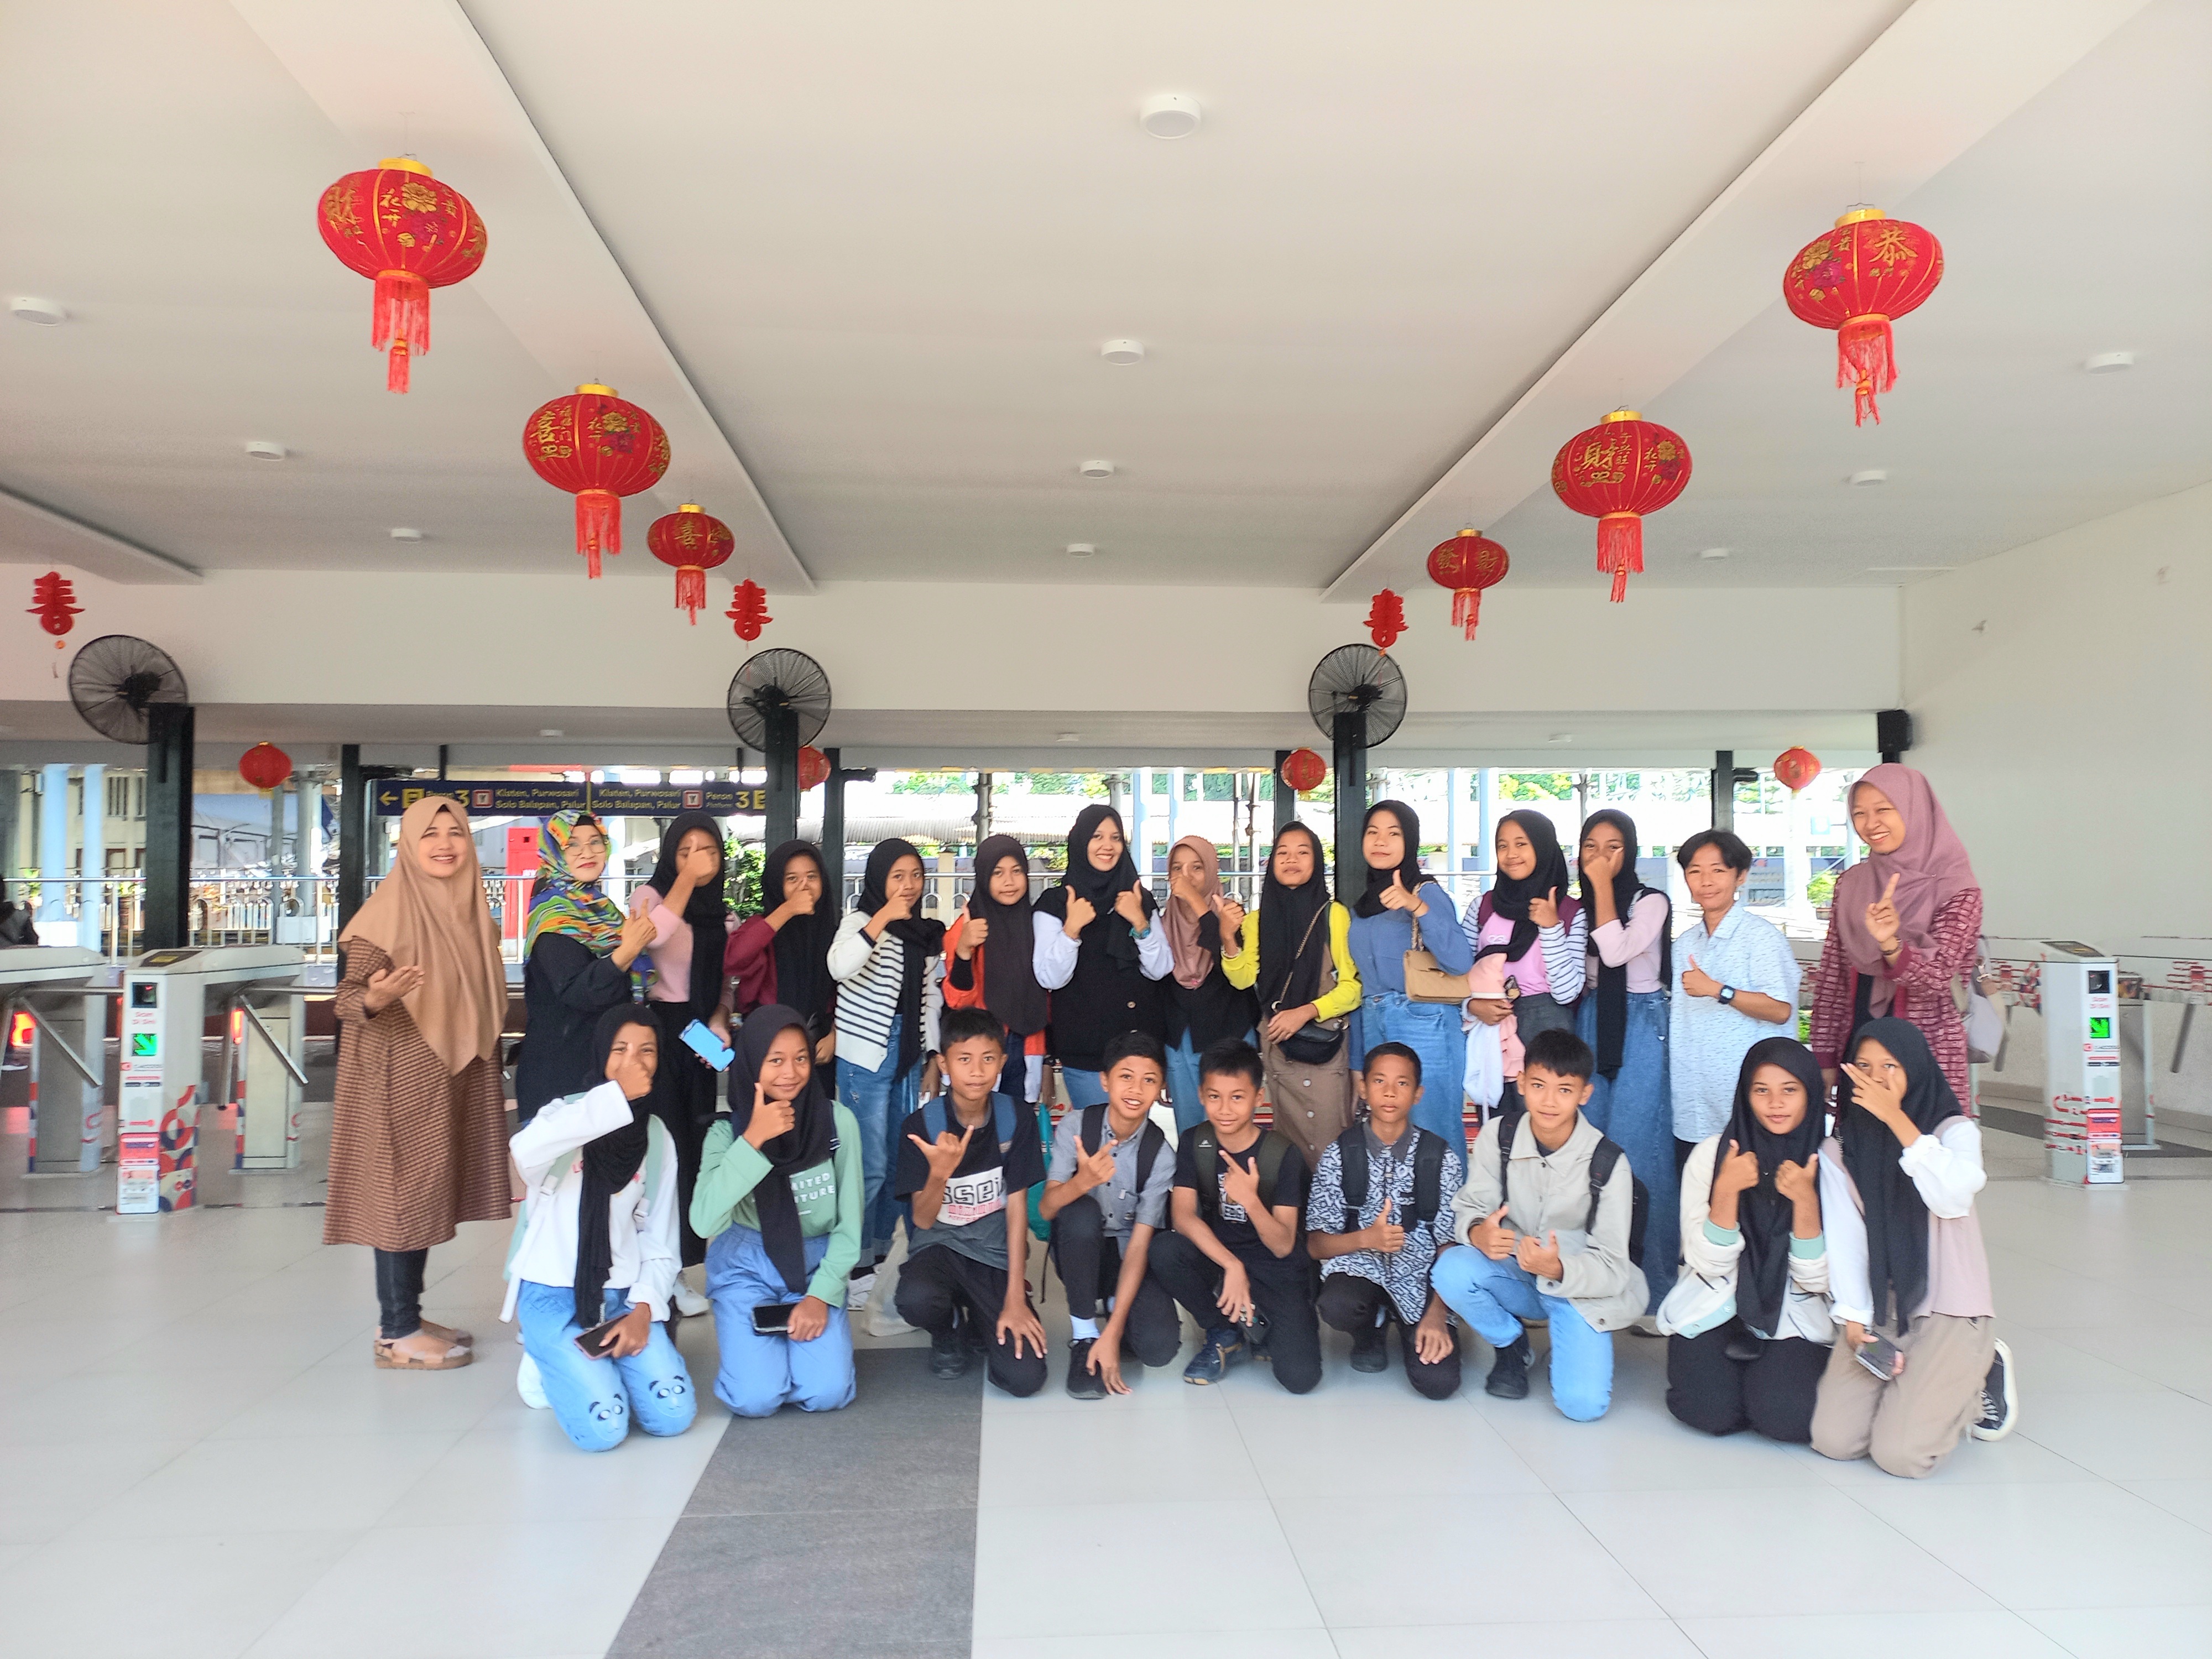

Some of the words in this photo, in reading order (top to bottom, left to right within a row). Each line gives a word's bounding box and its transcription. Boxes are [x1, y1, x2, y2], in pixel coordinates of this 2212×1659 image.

[1869, 226, 1918, 267] 恭
[455, 789, 470, 807] 3
[495, 800, 517, 808] Solo
[591, 800, 613, 808] Solo
[735, 790, 750, 809] 3
